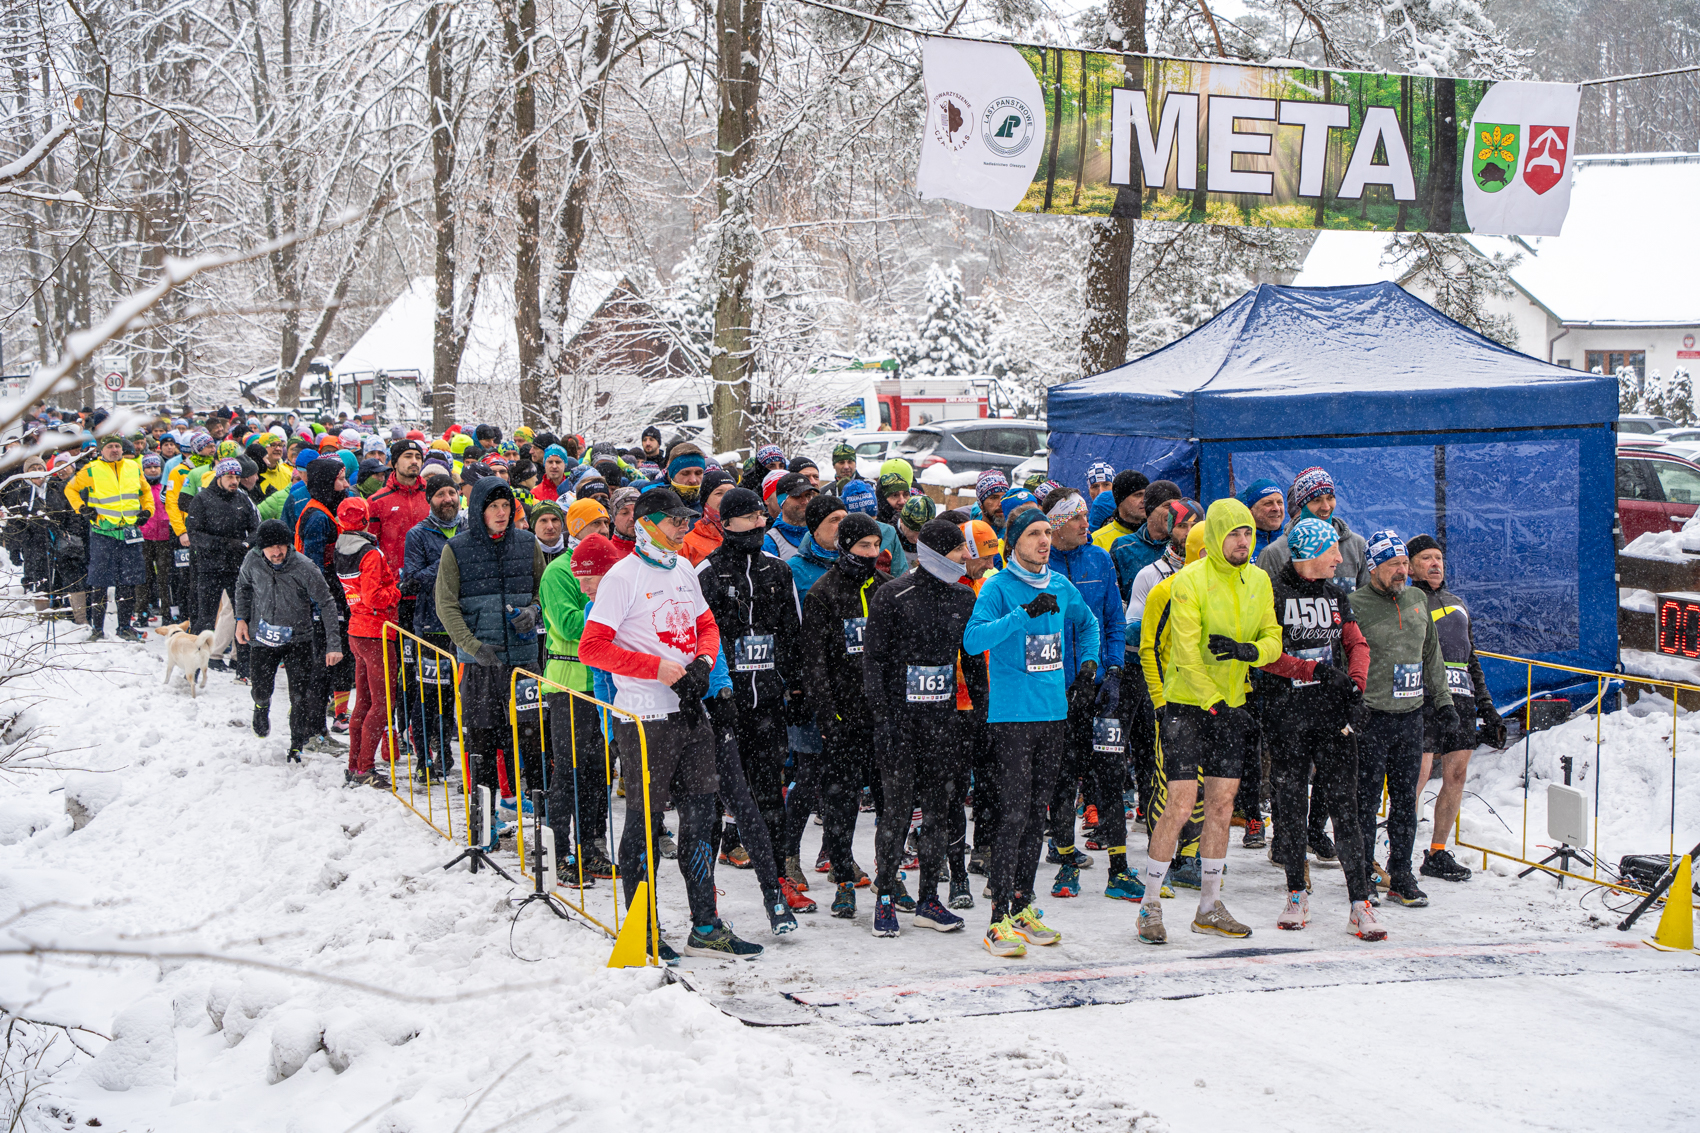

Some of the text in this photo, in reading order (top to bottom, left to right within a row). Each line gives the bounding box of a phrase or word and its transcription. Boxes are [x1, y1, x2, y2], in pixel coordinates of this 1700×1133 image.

[984, 105, 996, 124] LASY
[1110, 86, 1417, 202] META
[108, 377, 121, 387] 30
[131, 529, 137, 538] 8
[180, 552, 189, 561] 60
[1284, 598, 1332, 628] 450
[266, 630, 280, 641] 55
[1290, 624, 1342, 645] Oleszyce
[1660, 601, 1700, 658] 00
[746, 644, 768, 660] 127
[1040, 644, 1057, 659] 46
[424, 665, 438, 677] 77
[918, 675, 945, 691] 163
[1107, 727, 1121, 743] 37
